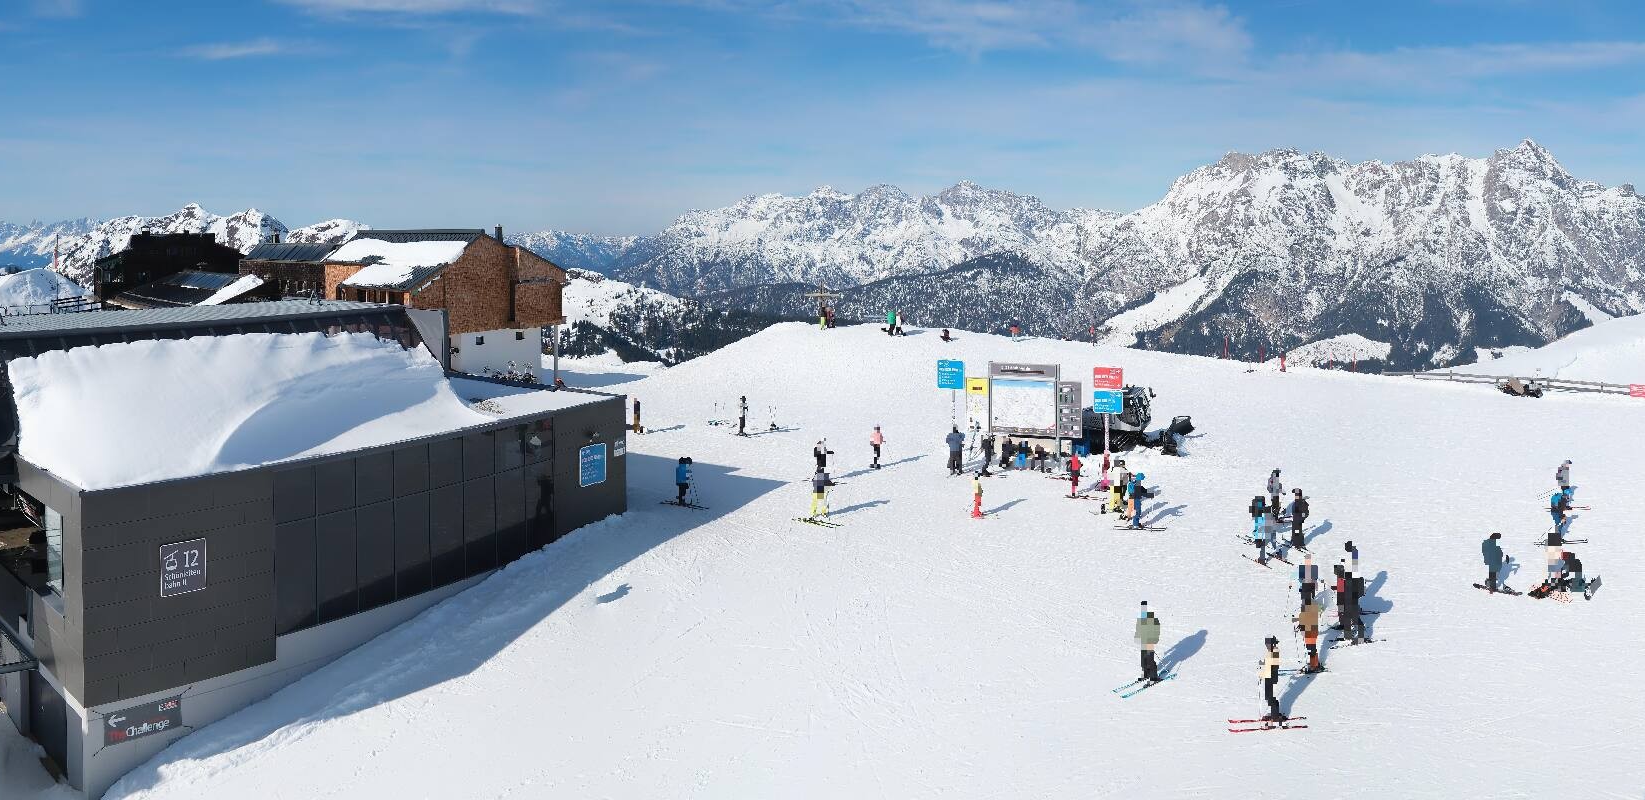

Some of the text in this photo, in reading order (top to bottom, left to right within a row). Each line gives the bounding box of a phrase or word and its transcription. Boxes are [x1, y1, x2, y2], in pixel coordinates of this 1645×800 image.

[184, 550, 199, 567] 12
[164, 581, 181, 589] bahn
[126, 719, 170, 737] Challenge
